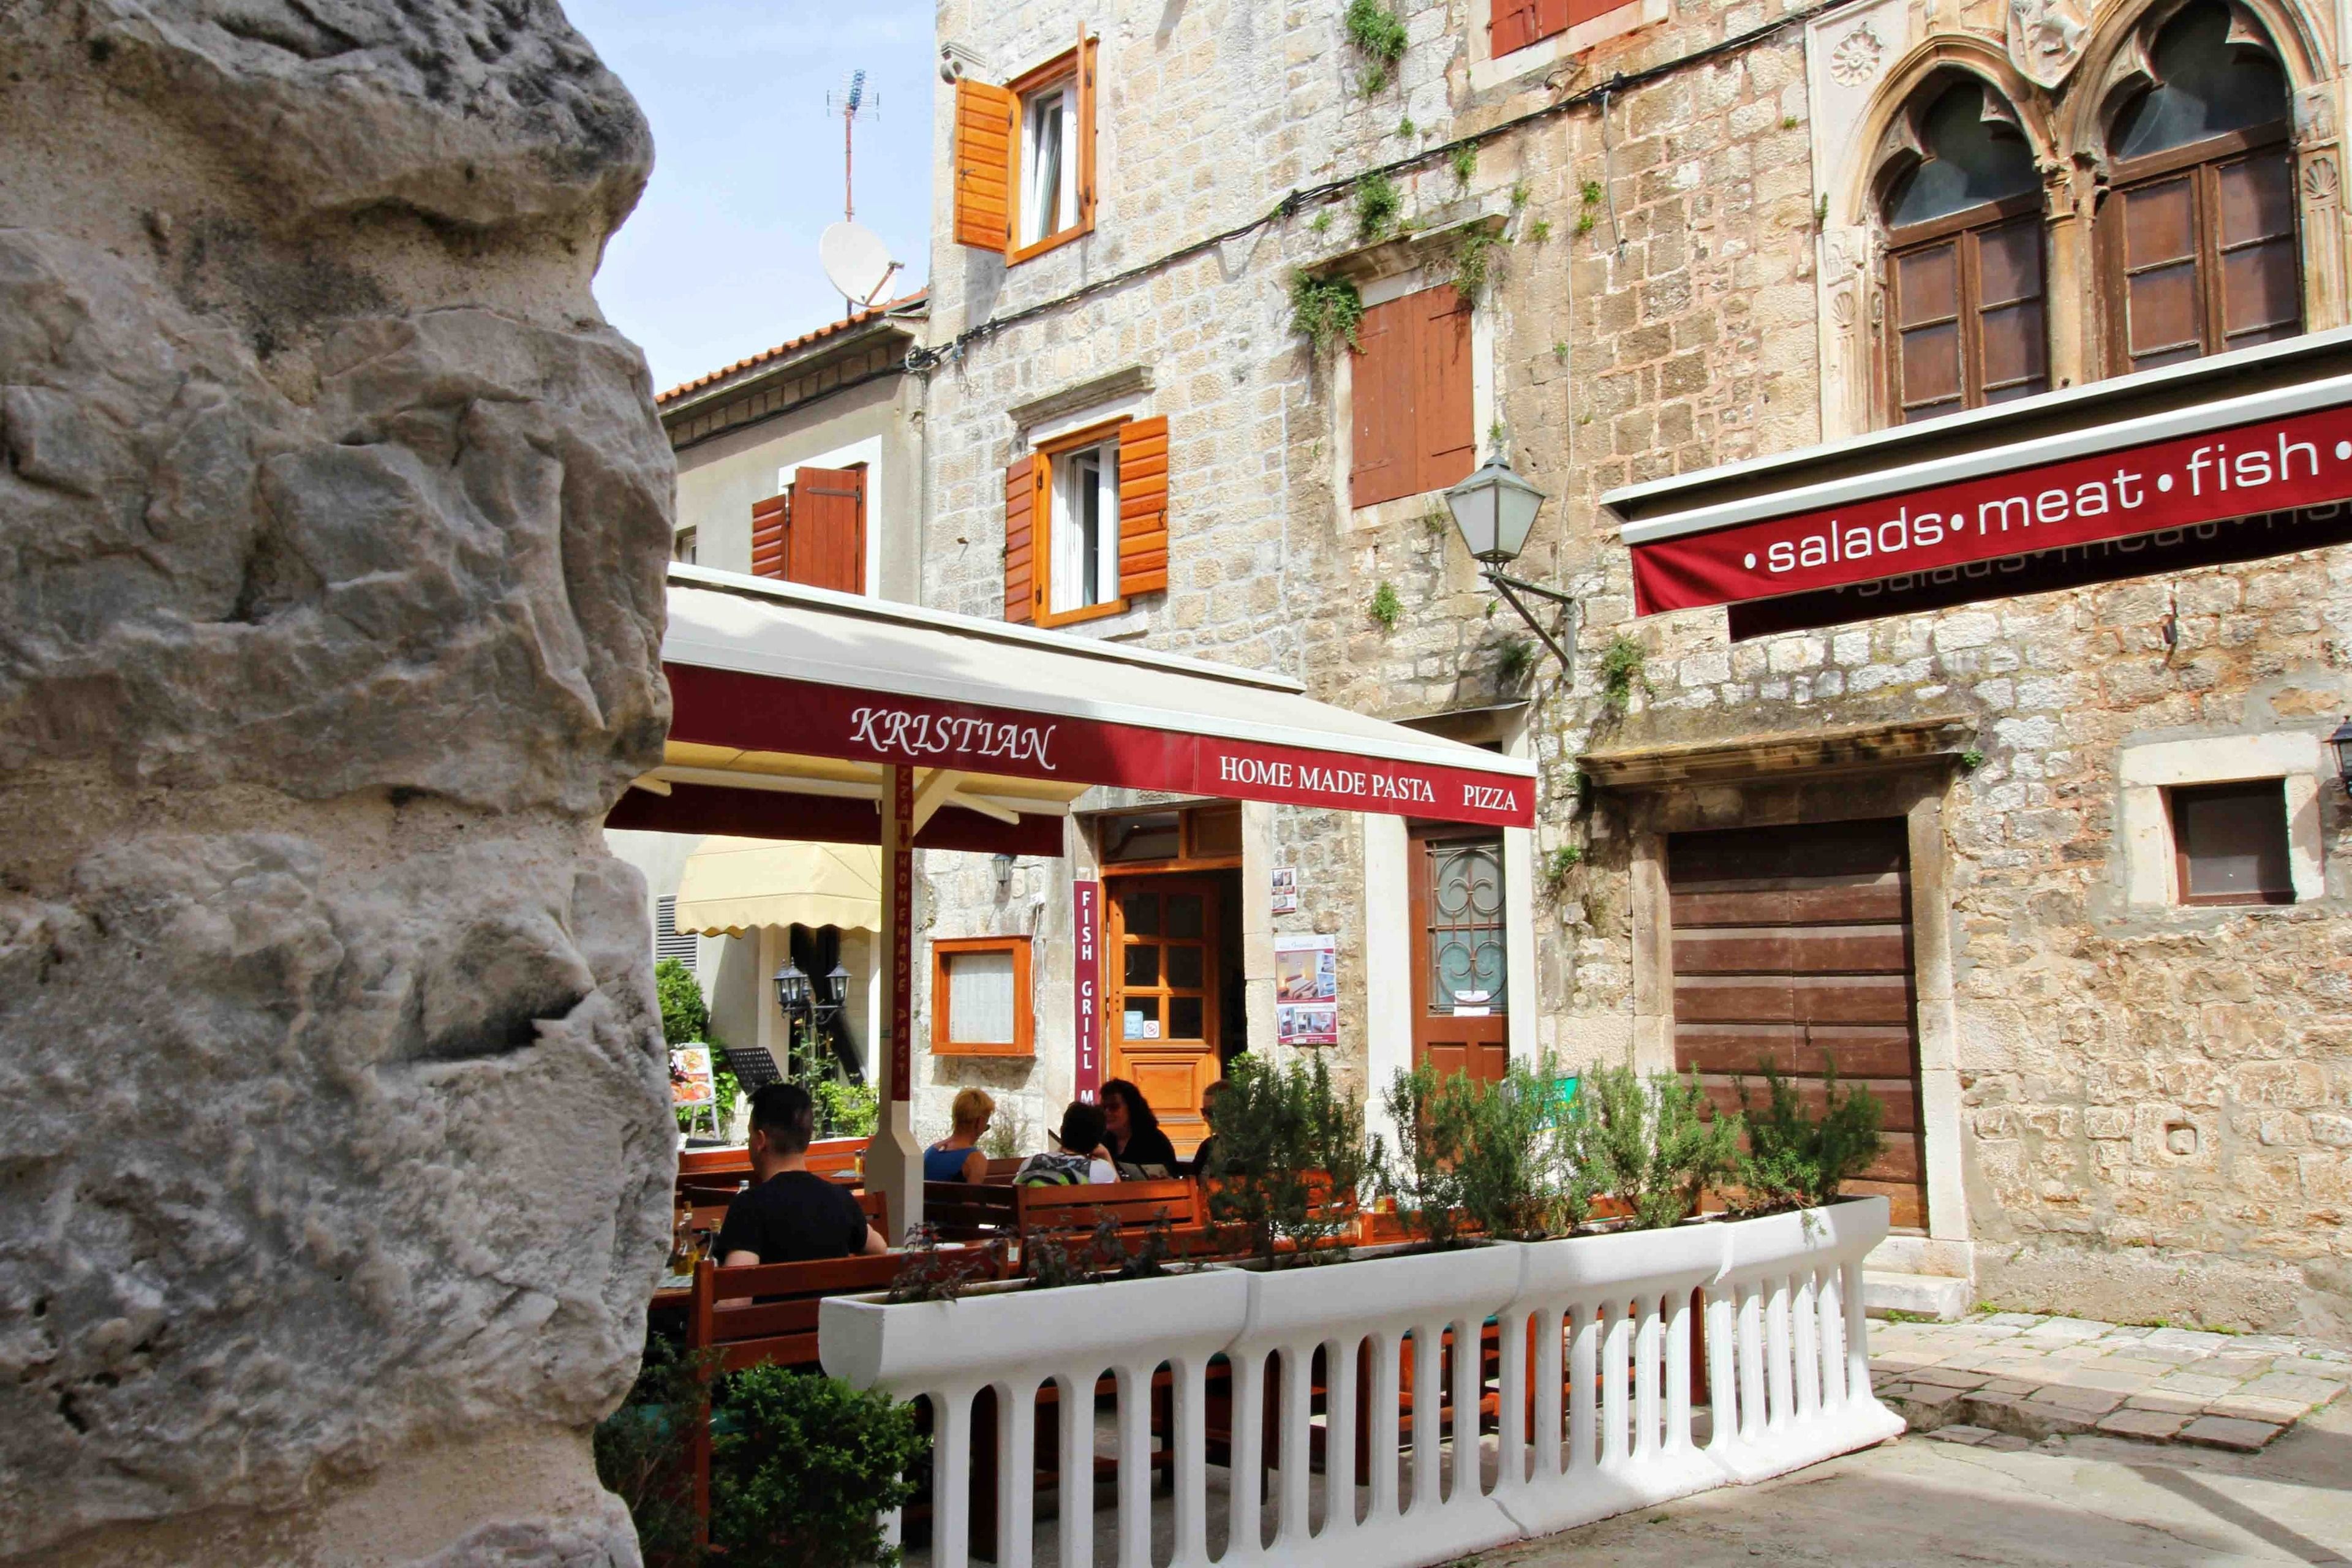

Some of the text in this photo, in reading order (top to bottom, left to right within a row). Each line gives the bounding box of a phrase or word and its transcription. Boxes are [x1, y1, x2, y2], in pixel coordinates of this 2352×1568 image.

[1768, 432, 2320, 573] salads meat fish
[849, 707, 1057, 771] KRISTIAN
[1219, 755, 1518, 812] HOME MADE PASTA PIZZA
[1082, 891, 1093, 961] FISH
[1082, 981, 1093, 1069] GRILL
